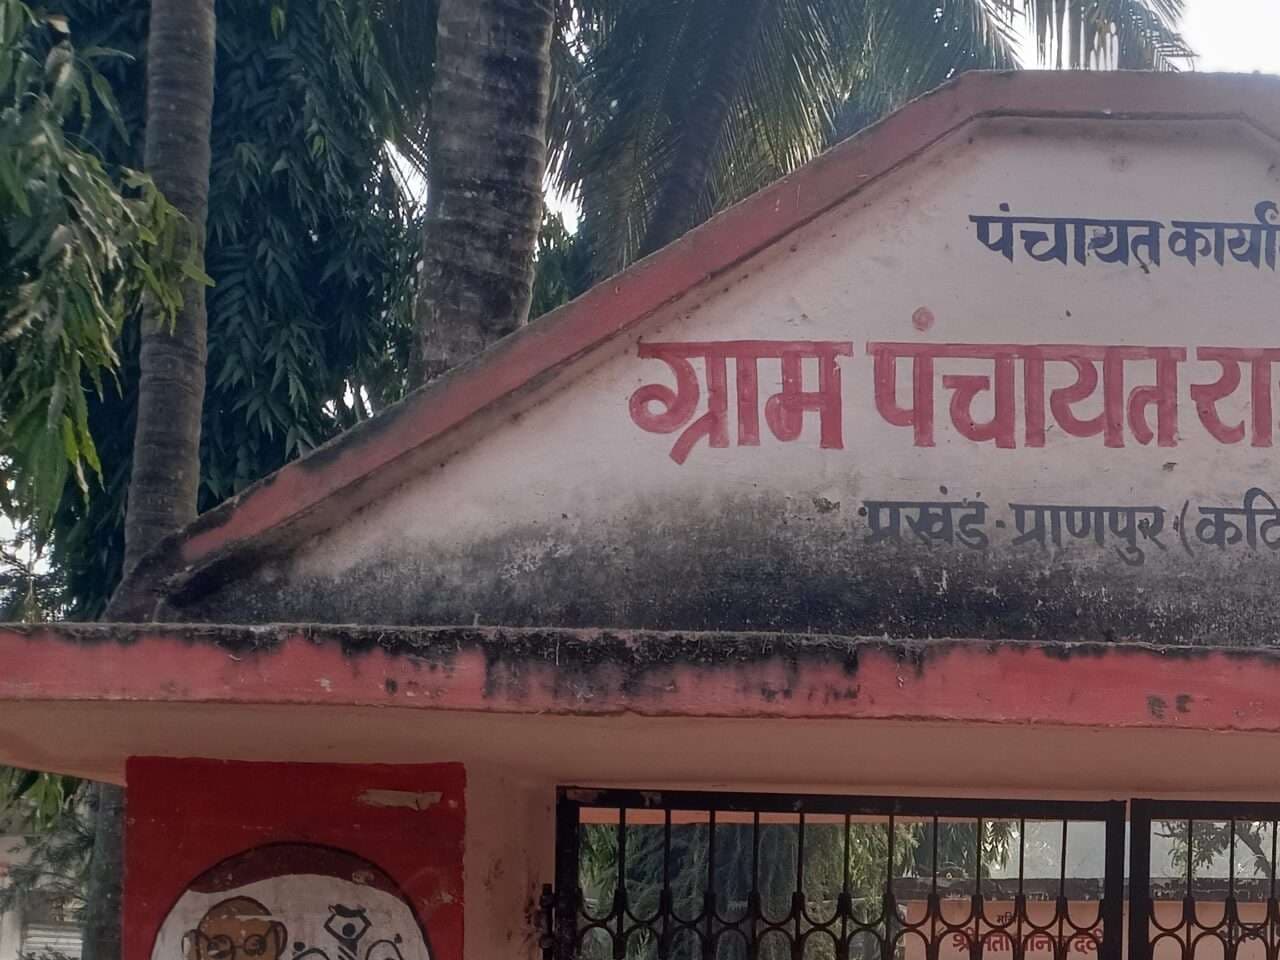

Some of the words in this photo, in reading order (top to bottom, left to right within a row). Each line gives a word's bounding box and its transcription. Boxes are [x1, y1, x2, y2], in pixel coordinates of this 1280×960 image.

[968, 202, 1165, 273] पंचायत
[629, 339, 854, 465] ग्राम
[866, 306, 1187, 448] पंचायत
